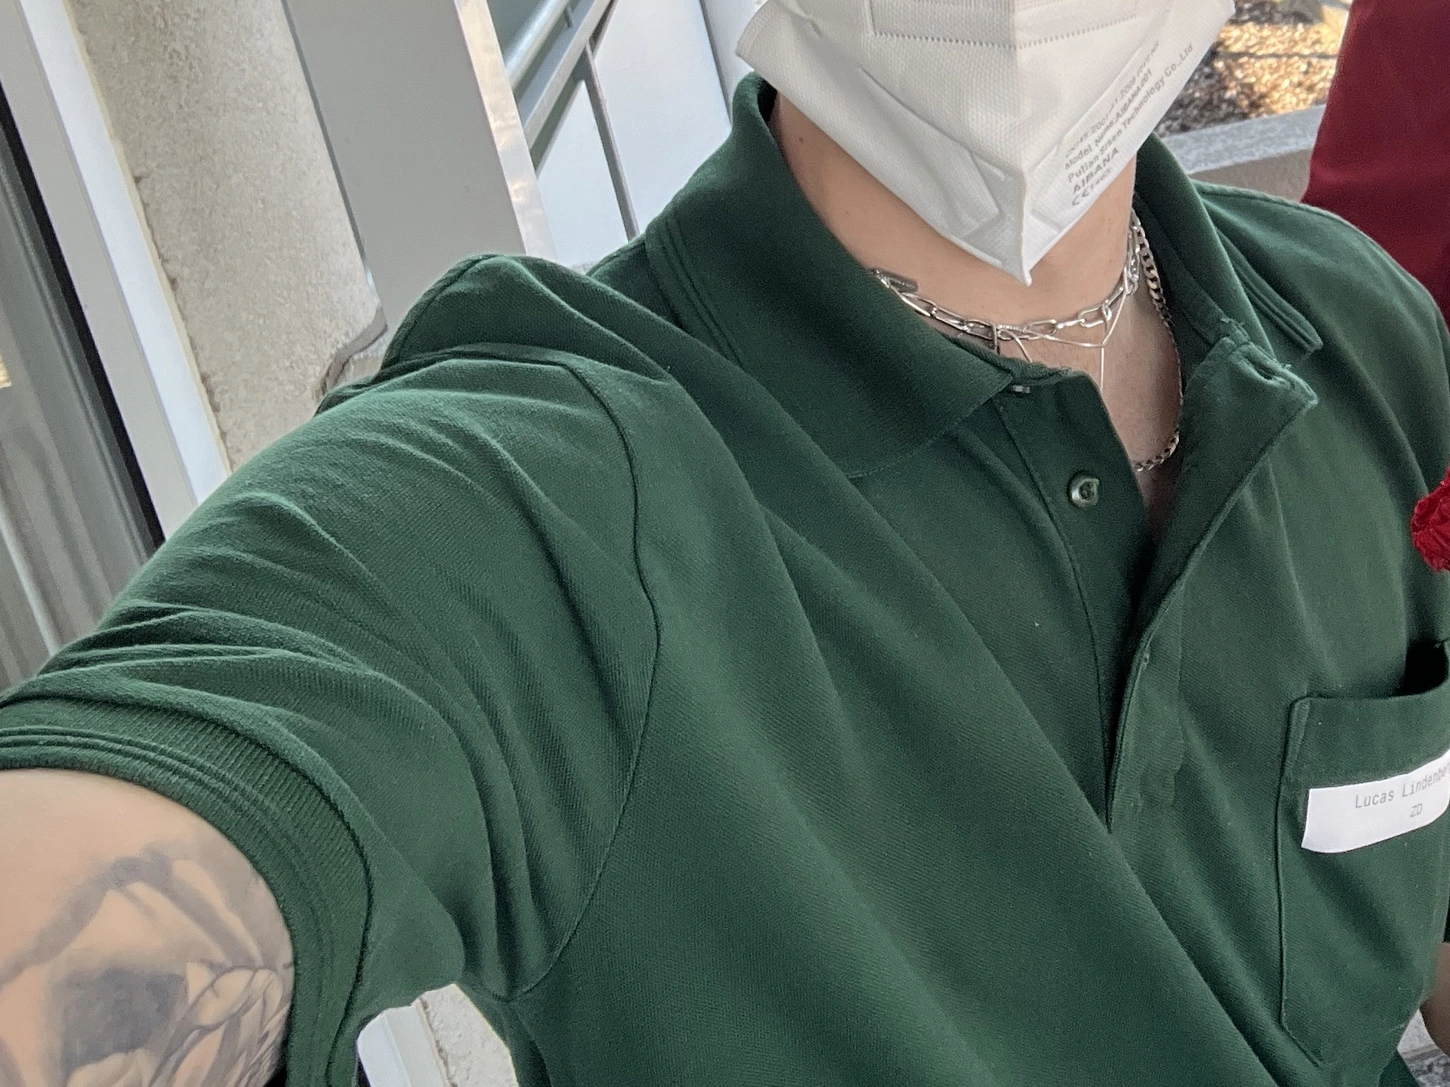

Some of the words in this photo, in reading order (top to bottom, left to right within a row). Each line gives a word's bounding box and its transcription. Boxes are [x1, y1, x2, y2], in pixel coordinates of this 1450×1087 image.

[1122, 76, 1165, 130] Technology
[1073, 147, 1119, 195] AIBANA
[1355, 790, 1395, 809] Lucas
[1410, 803, 1423, 818] ZD
